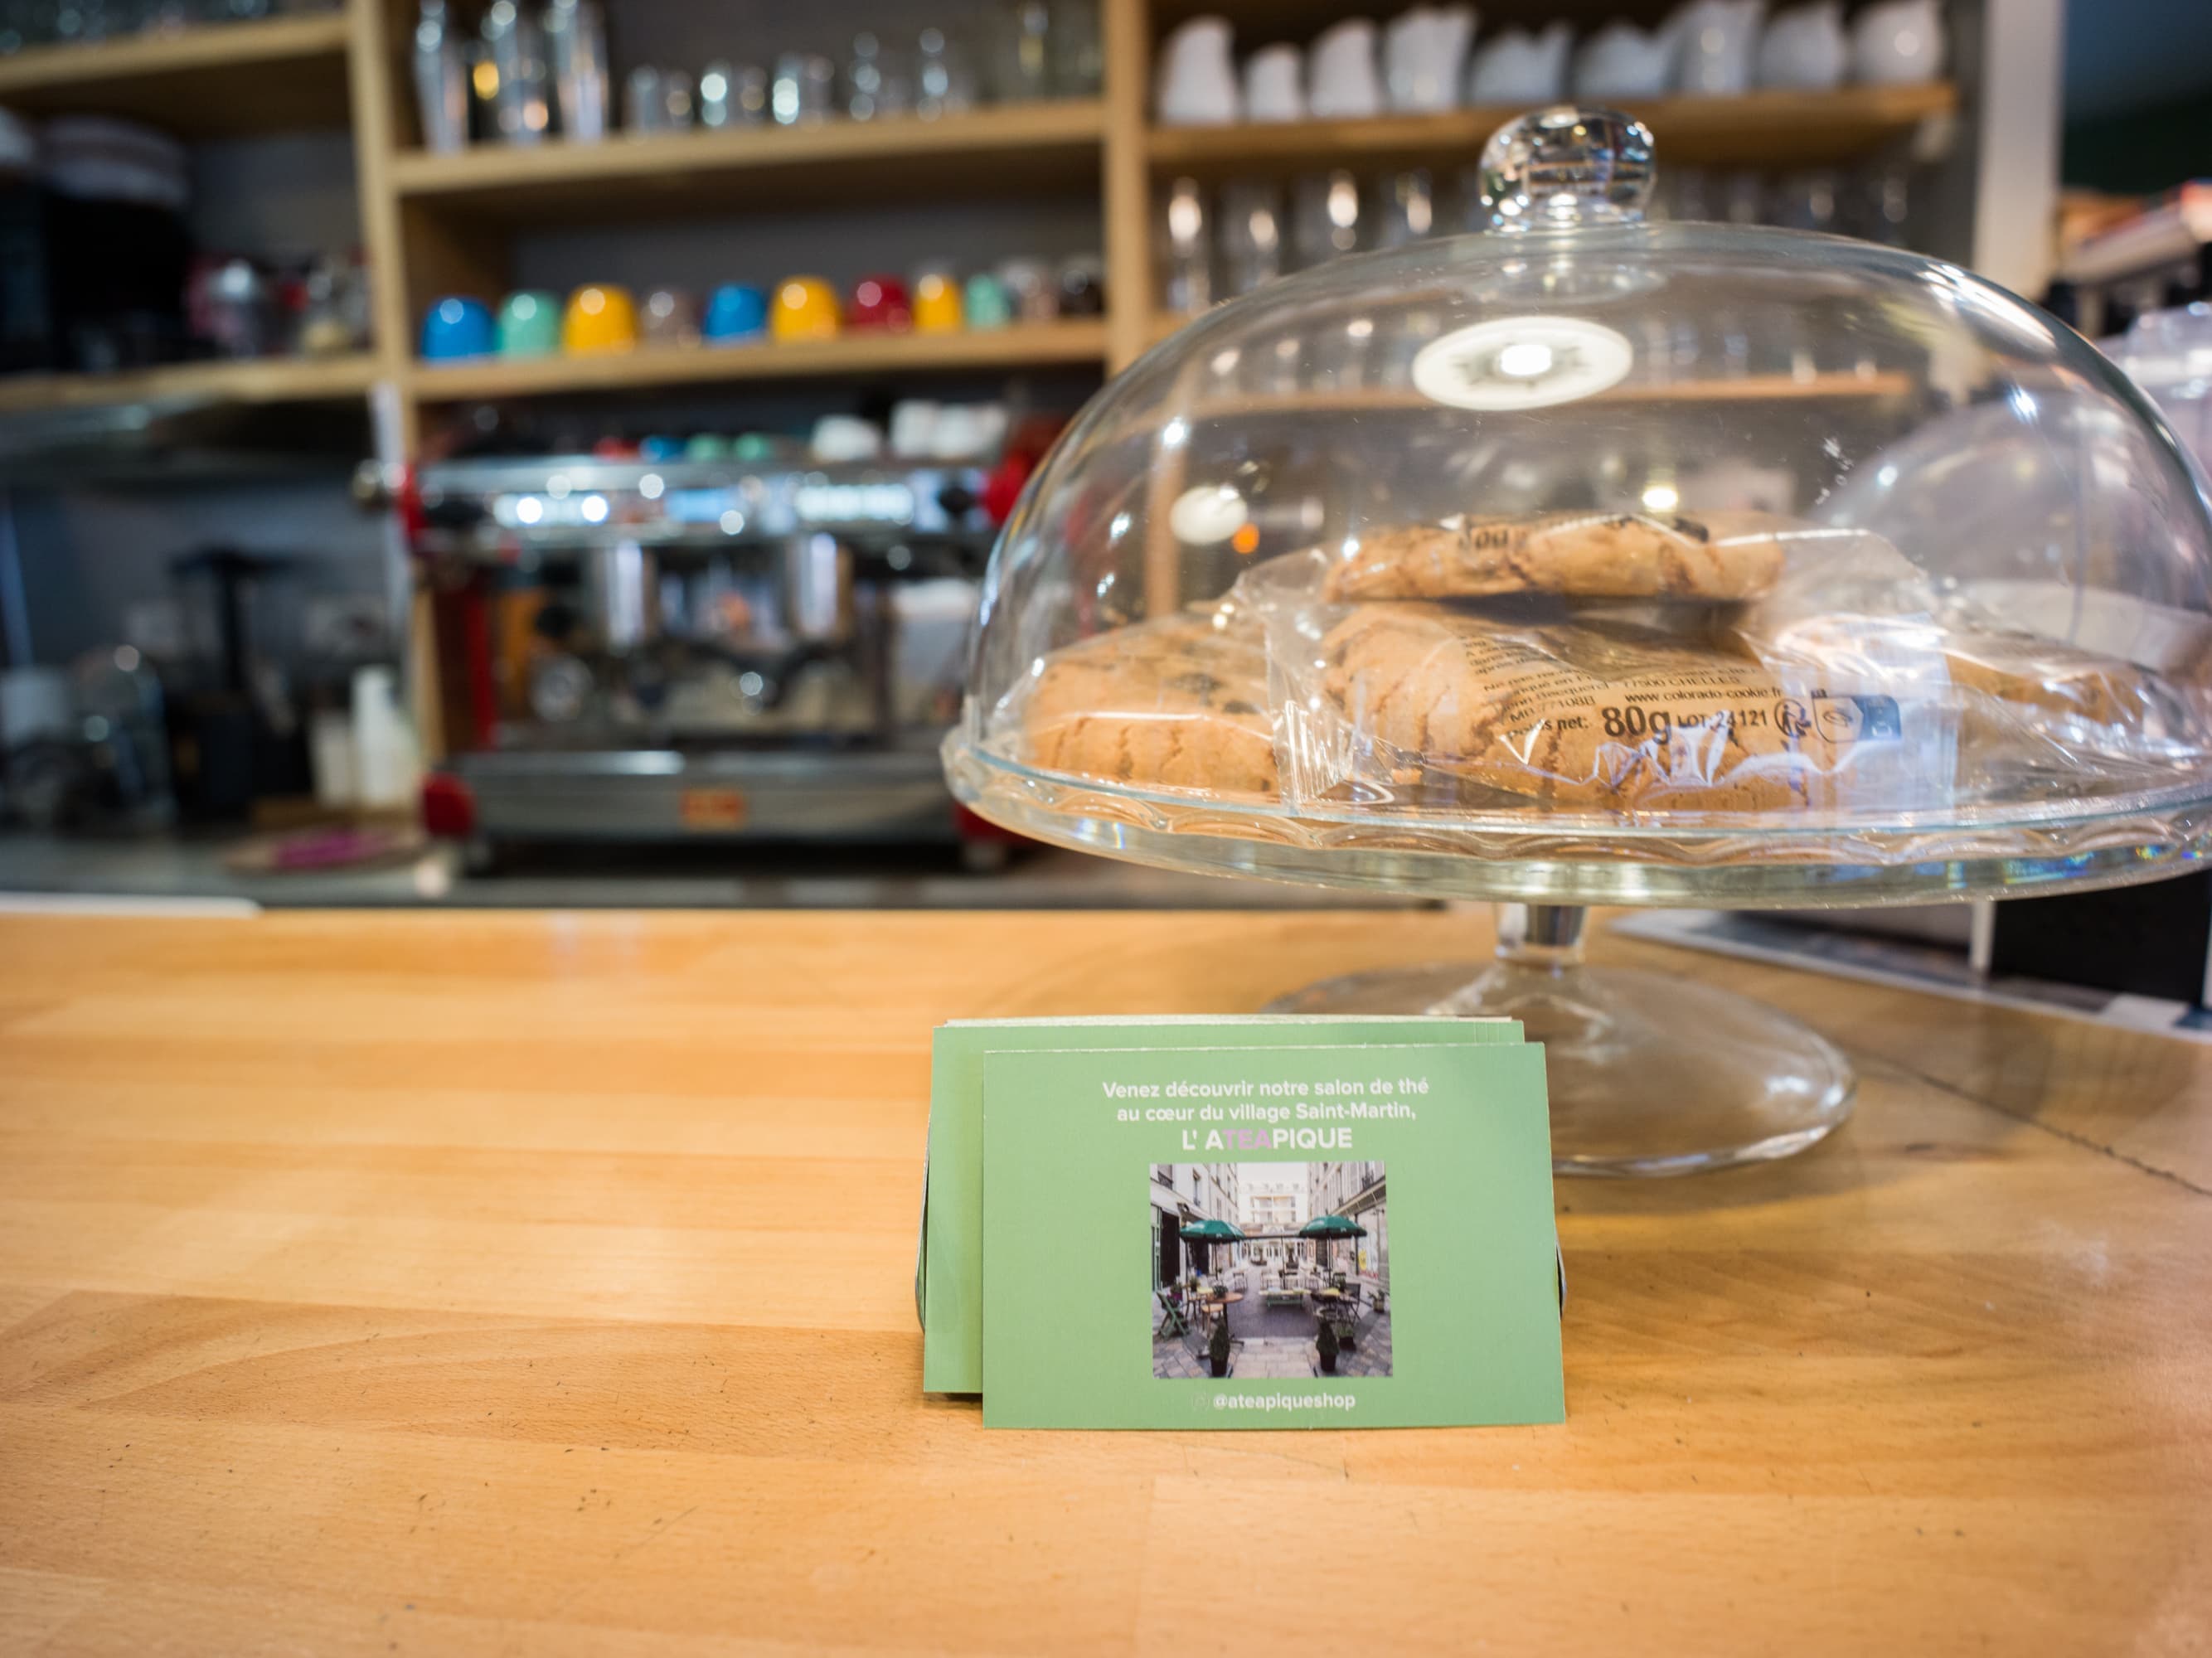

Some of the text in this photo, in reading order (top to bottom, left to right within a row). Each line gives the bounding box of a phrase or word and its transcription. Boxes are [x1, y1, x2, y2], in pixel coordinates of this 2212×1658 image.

[1601, 705, 1671, 745] 80g
[1102, 1076, 1429, 1098] Venez découvrir notre salon de thé
[1117, 1101, 1417, 1124] au cœur du village Saint-Martin,
[1181, 1127, 1353, 1151] L' ATEAPIQUE
[1213, 1392, 1356, 1412] @ateapiqueshop
